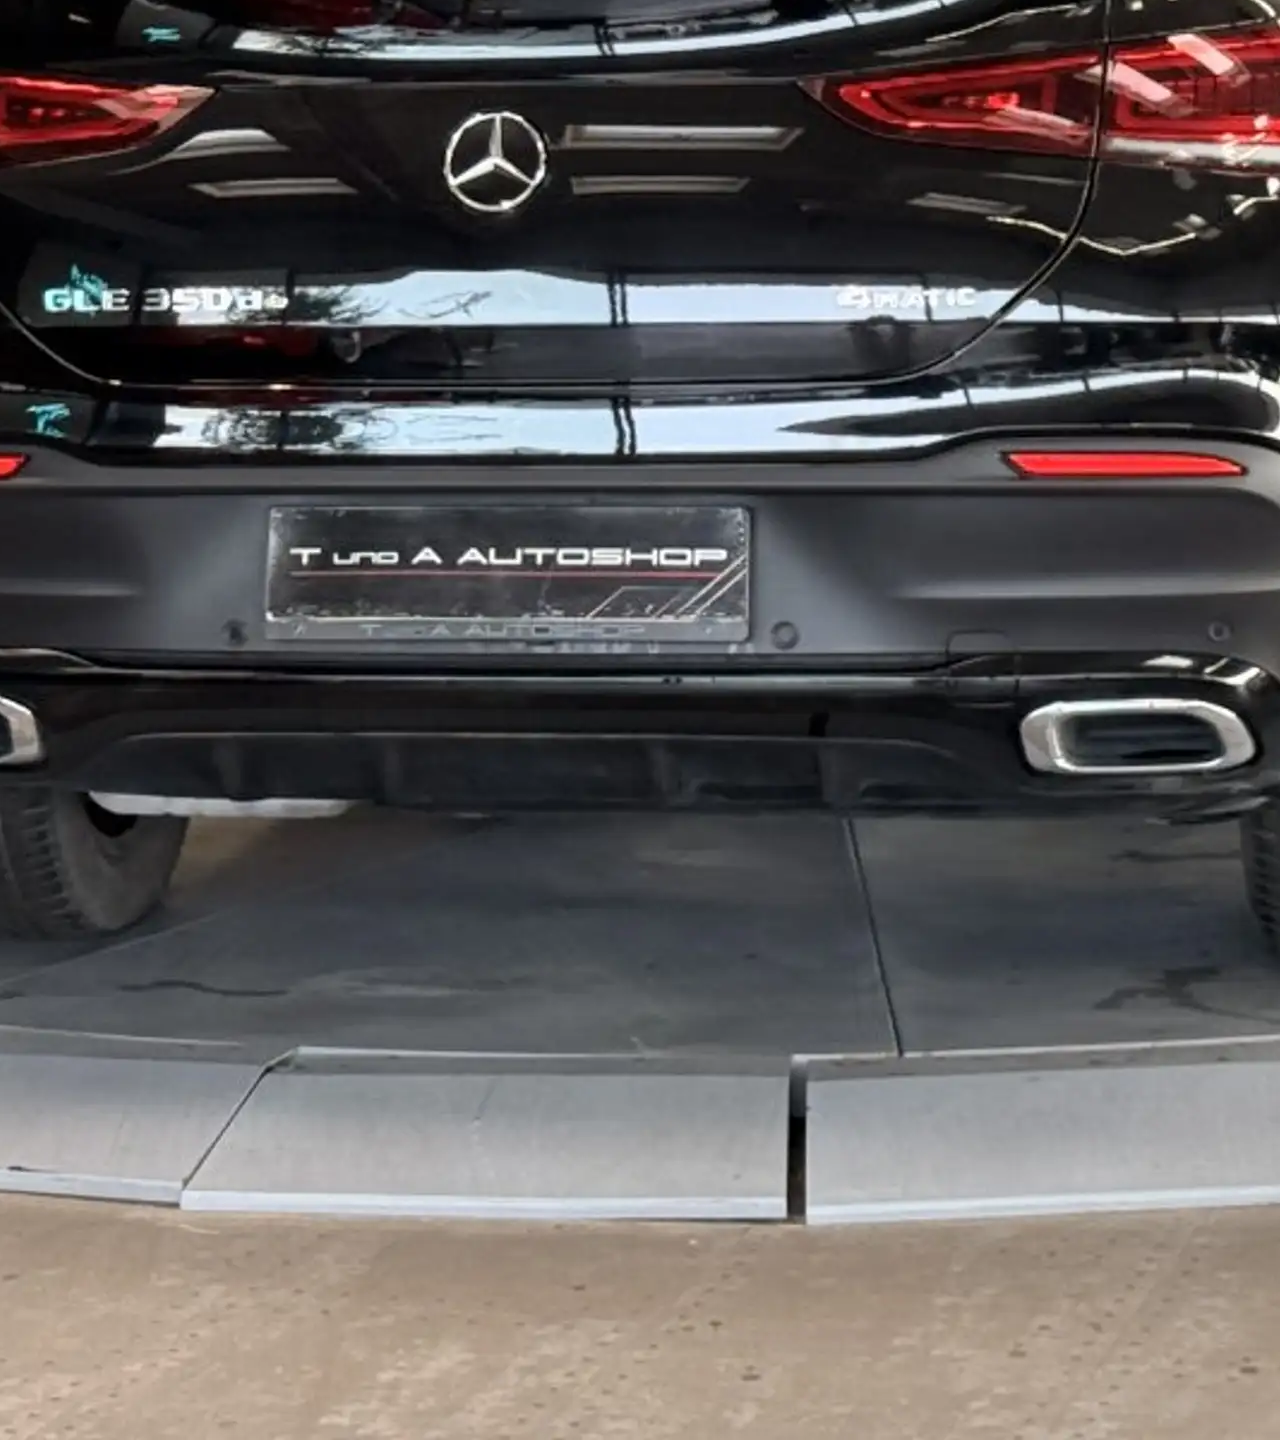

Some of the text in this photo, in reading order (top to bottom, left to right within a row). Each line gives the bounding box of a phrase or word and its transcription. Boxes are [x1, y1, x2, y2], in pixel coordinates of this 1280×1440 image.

[43, 287, 130, 312] GLE
[289, 547, 322, 566] T
[411, 547, 442, 565] A
[456, 546, 728, 566] AUTOSHOP
